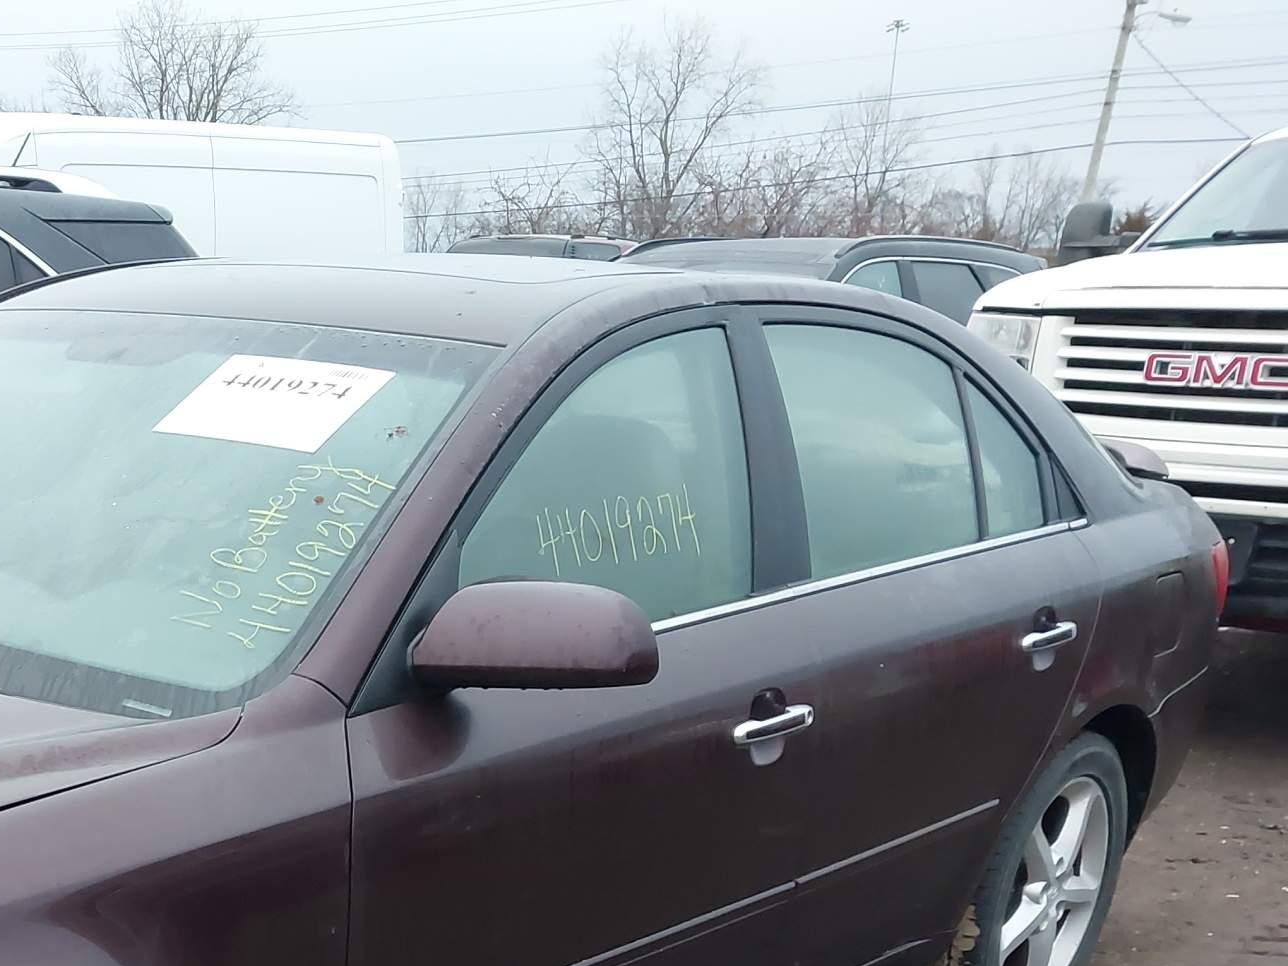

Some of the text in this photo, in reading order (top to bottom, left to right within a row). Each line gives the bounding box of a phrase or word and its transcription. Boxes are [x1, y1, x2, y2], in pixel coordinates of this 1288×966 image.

[222, 373, 352, 399] 44019274
[1143, 352, 1288, 390] GMC
[536, 483, 701, 577] 44019274
[227, 468, 397, 649] 44019274
[169, 579, 242, 629] No
